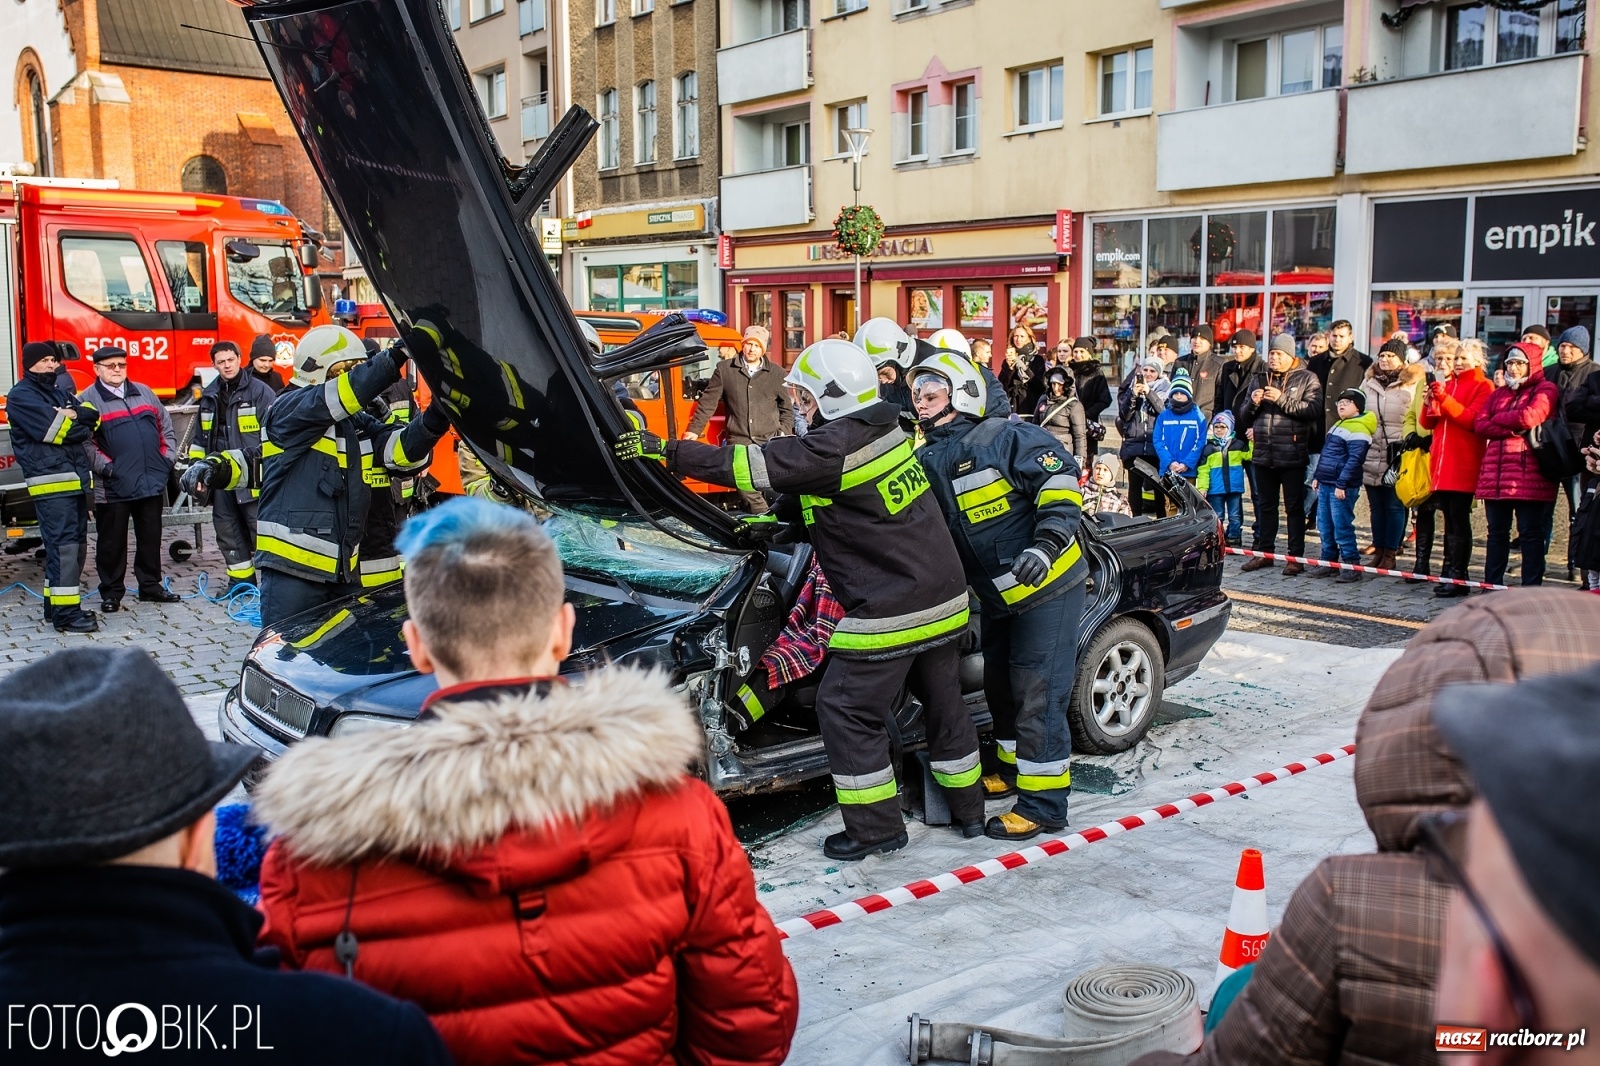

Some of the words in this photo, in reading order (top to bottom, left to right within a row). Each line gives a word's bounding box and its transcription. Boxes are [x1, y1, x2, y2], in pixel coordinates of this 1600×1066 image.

[1061, 213, 1071, 250] ŻYWIEC
[1485, 209, 1596, 254] empik
[1096, 247, 1141, 264] empik.com
[131, 343, 137, 354] S
[142, 337, 168, 360] 32
[192, 337, 215, 345] 280
